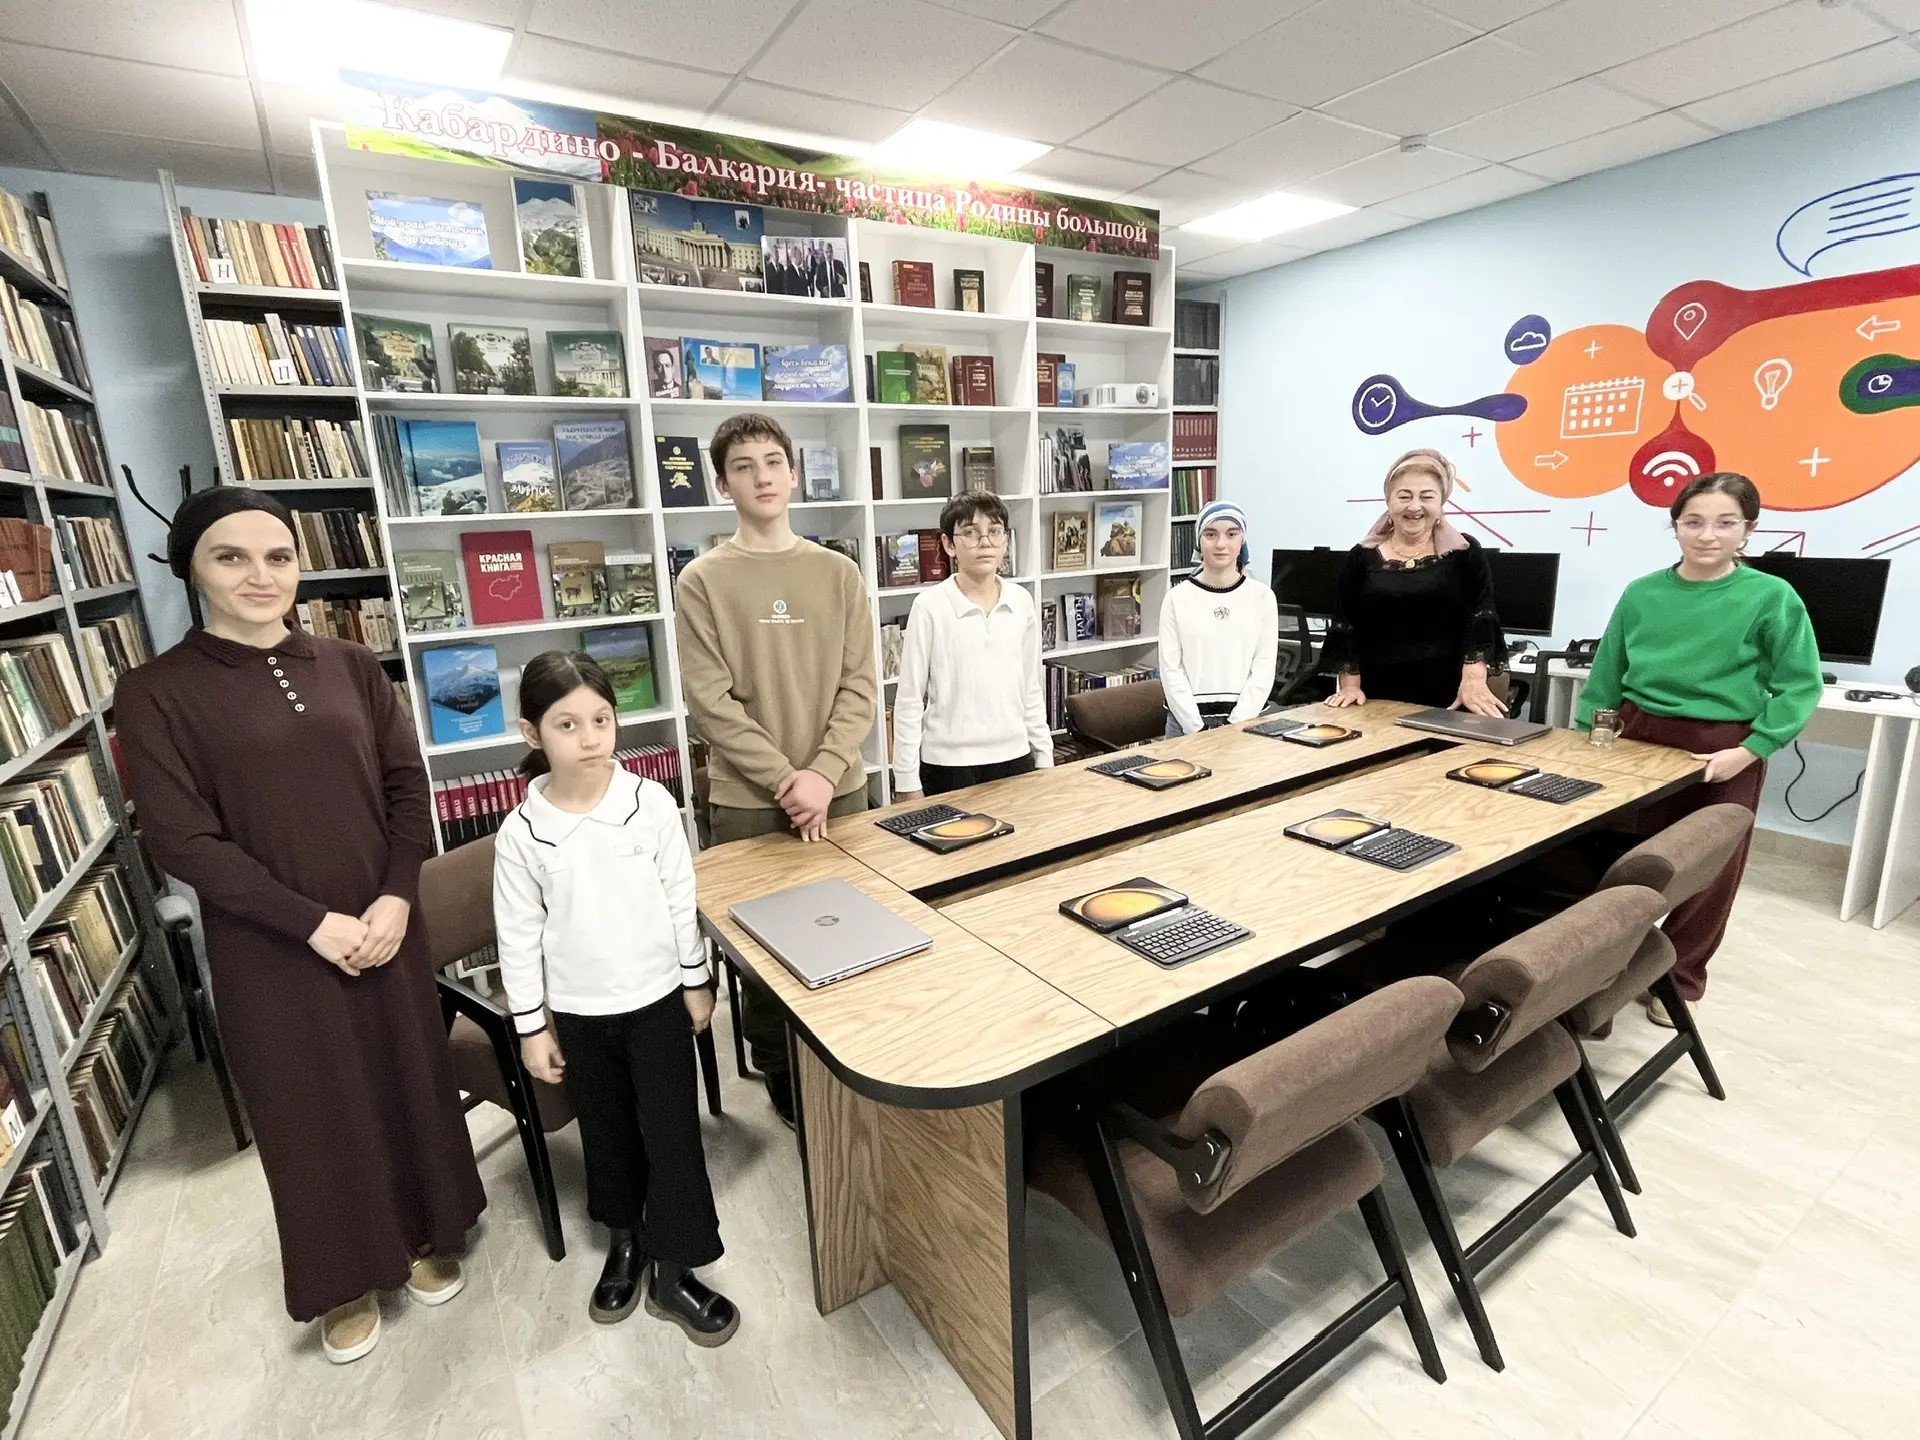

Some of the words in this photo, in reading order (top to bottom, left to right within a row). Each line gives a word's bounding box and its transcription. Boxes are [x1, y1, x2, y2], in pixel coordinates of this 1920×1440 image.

[378, 91, 621, 162] Кабардино
[835, 176, 952, 213] частица
[954, 189, 1051, 228] Родины
[1056, 206, 1148, 243] большой
[217, 264, 230, 279] Н
[278, 366, 291, 381] П
[478, 552, 523, 563] КРАСНАЯ
[480, 562, 510, 572] КНИГА
[1075, 596, 1085, 637] НАРТЫ
